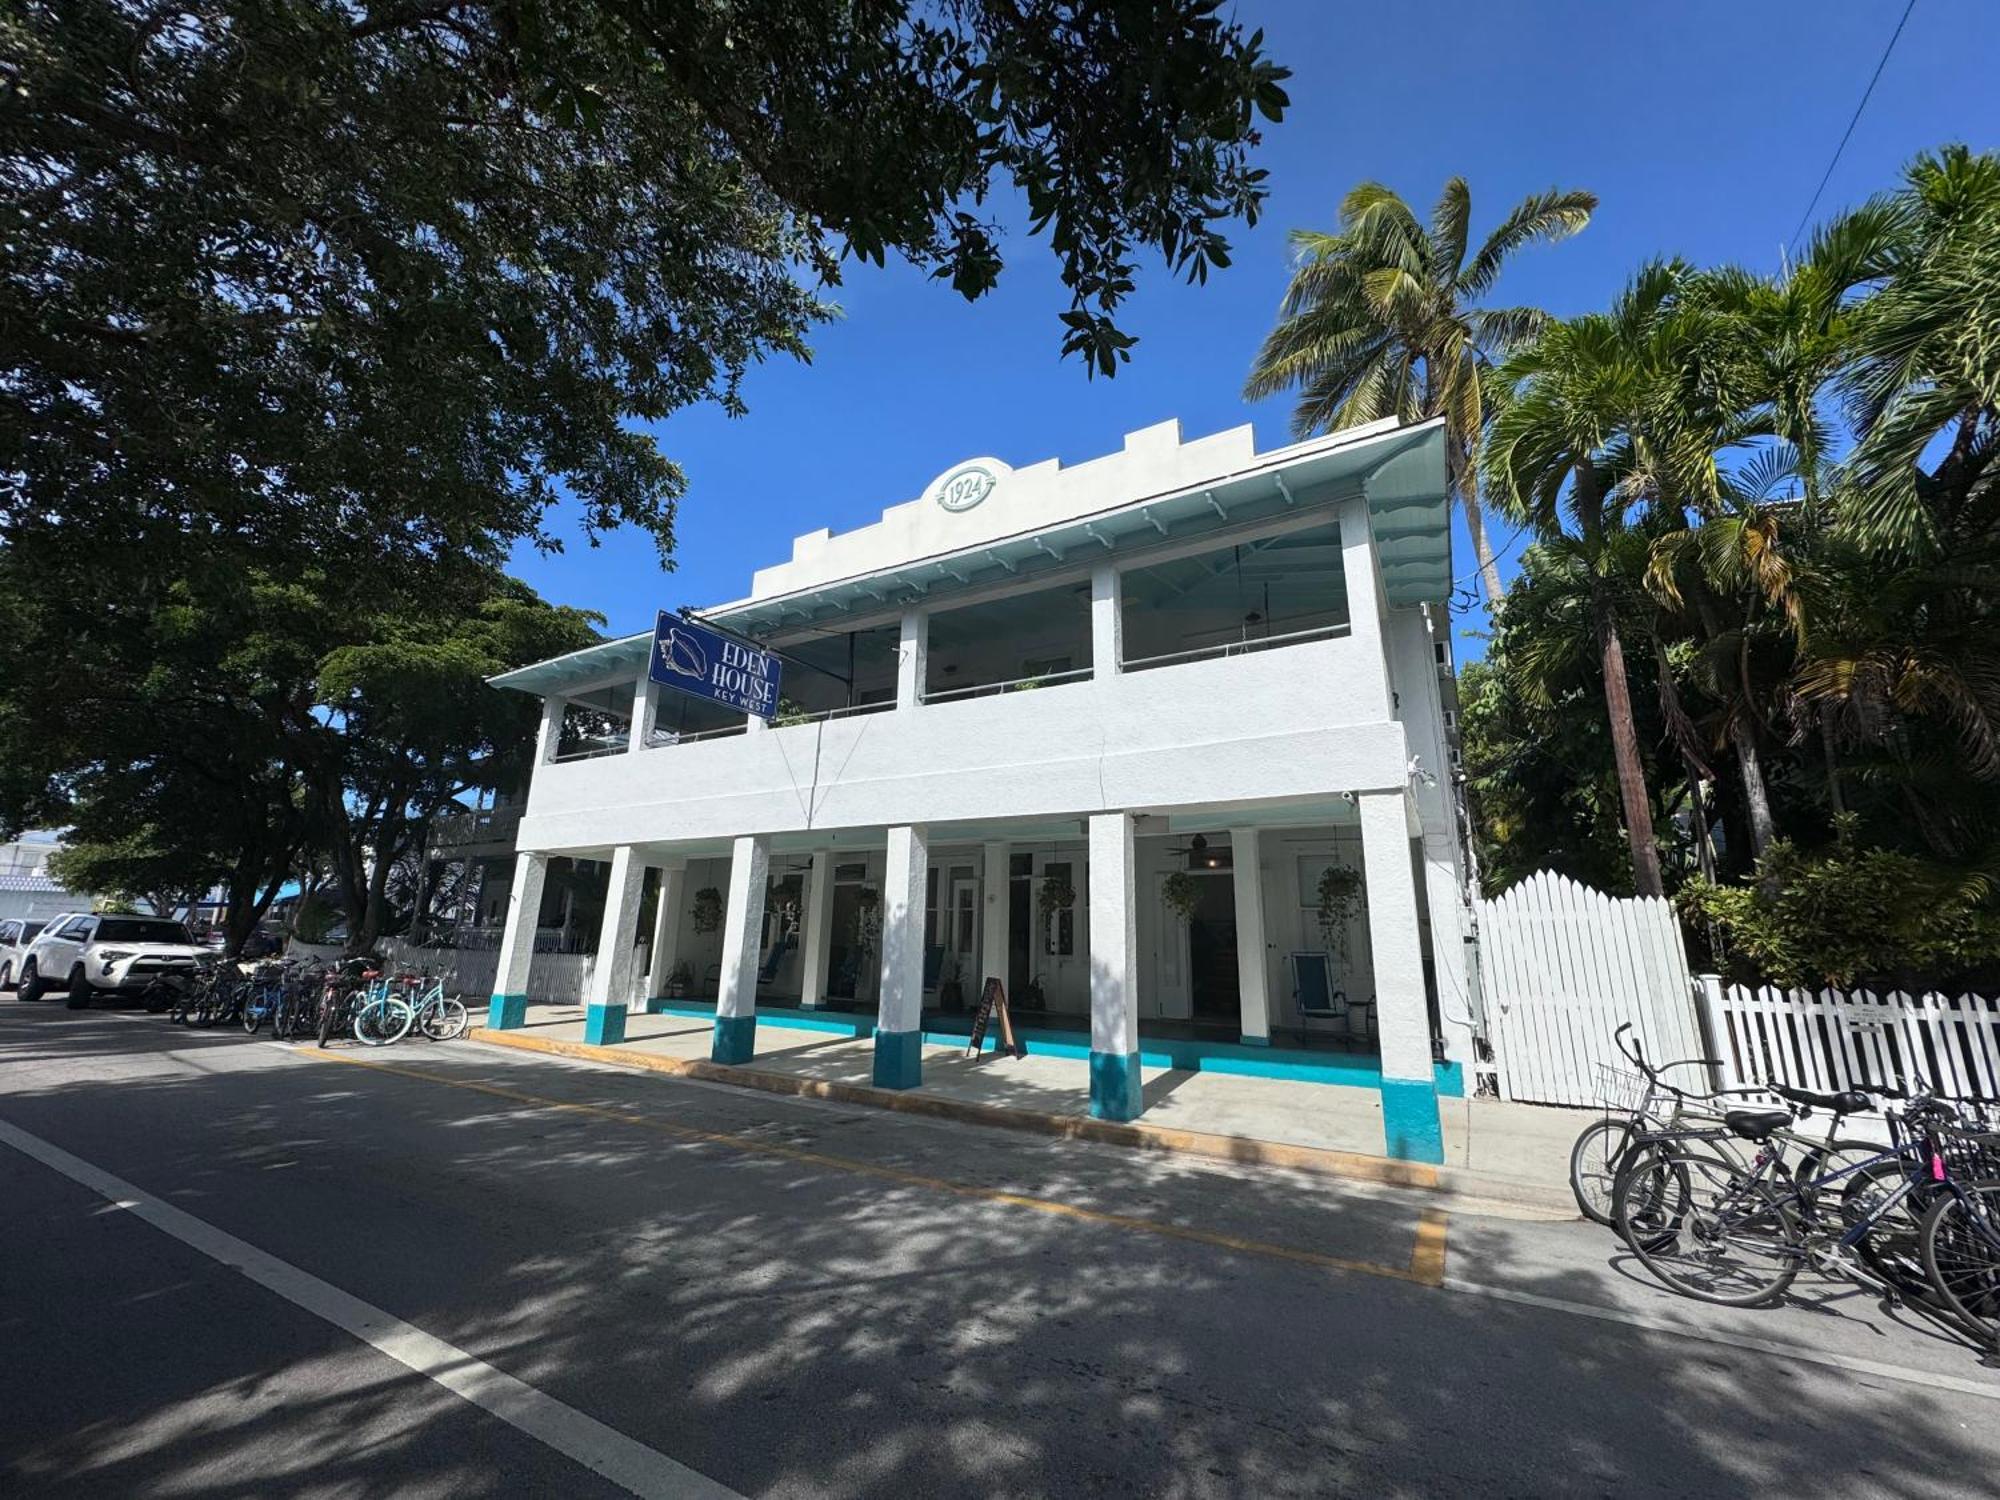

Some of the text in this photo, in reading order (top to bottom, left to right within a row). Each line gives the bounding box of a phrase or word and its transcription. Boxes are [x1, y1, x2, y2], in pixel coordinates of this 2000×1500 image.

[950, 475, 982, 504] 1924
[721, 642, 770, 679] EDEN
[712, 663, 774, 704] HOUSE
[714, 688, 767, 713] KEY WEST
